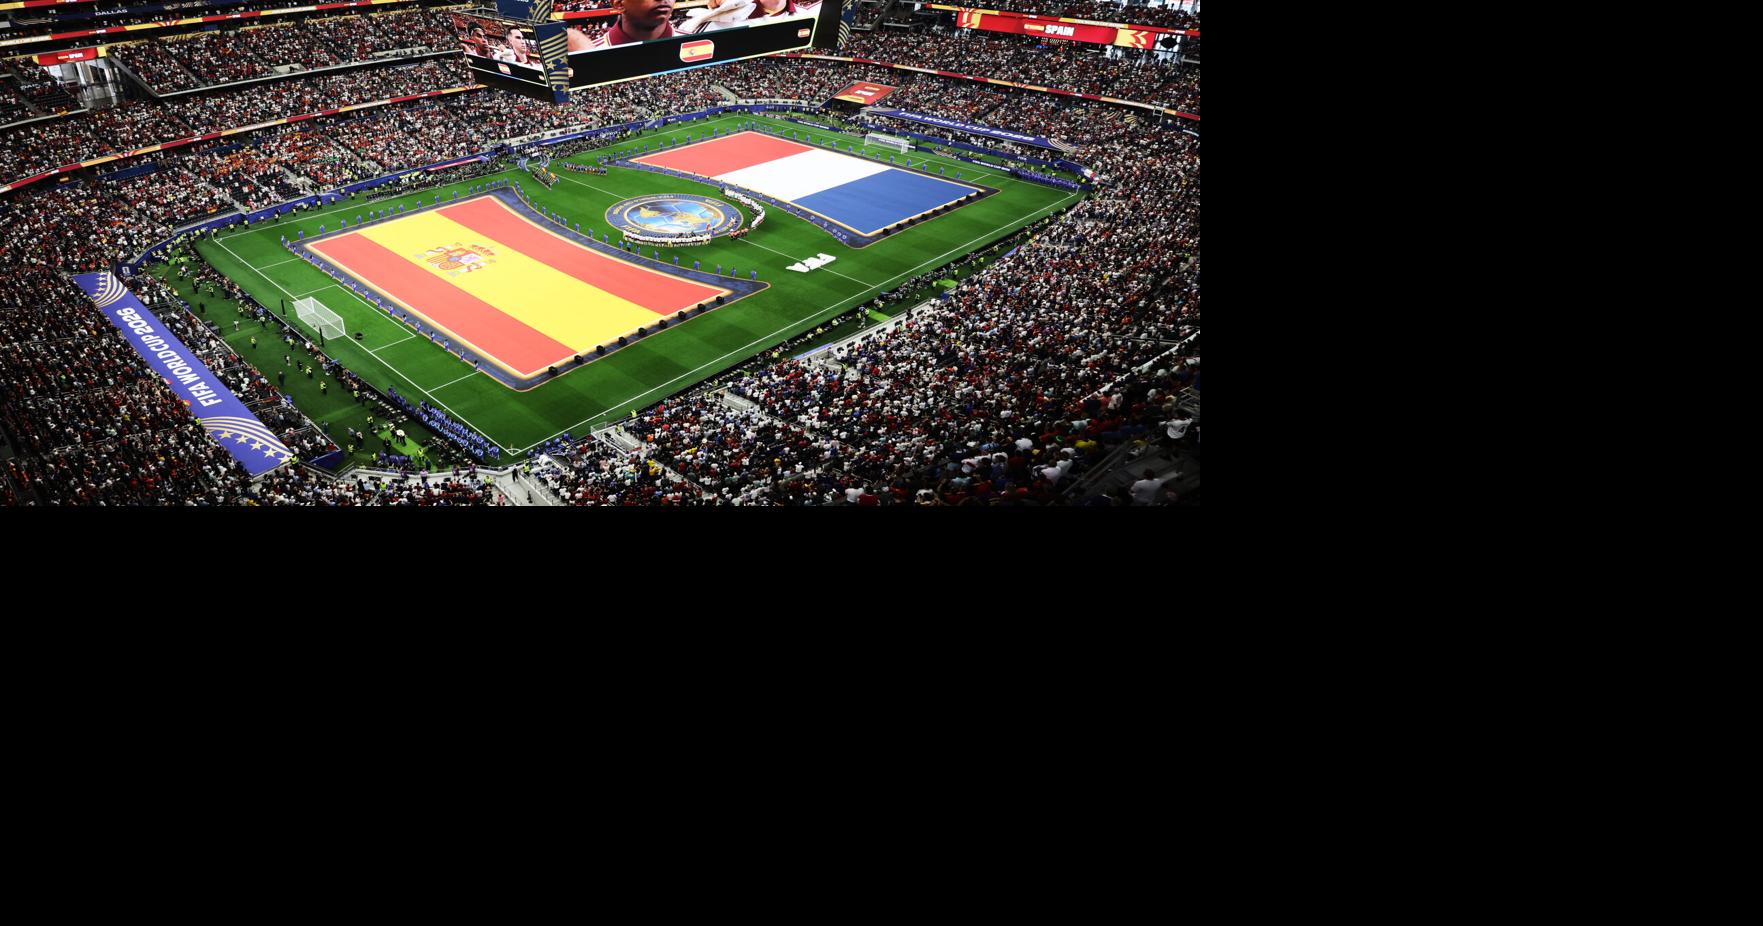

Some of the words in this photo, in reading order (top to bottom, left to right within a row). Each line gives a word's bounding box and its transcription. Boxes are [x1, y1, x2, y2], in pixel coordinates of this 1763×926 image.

[1044, 24, 1075, 37] SPAIN
[924, 117, 965, 127] WORLD
[990, 130, 1035, 141] 2026
[116, 307, 154, 335] 2026
[140, 334, 170, 352] CUP
[157, 350, 200, 385] WORLD
[188, 381, 222, 407] FIFA
